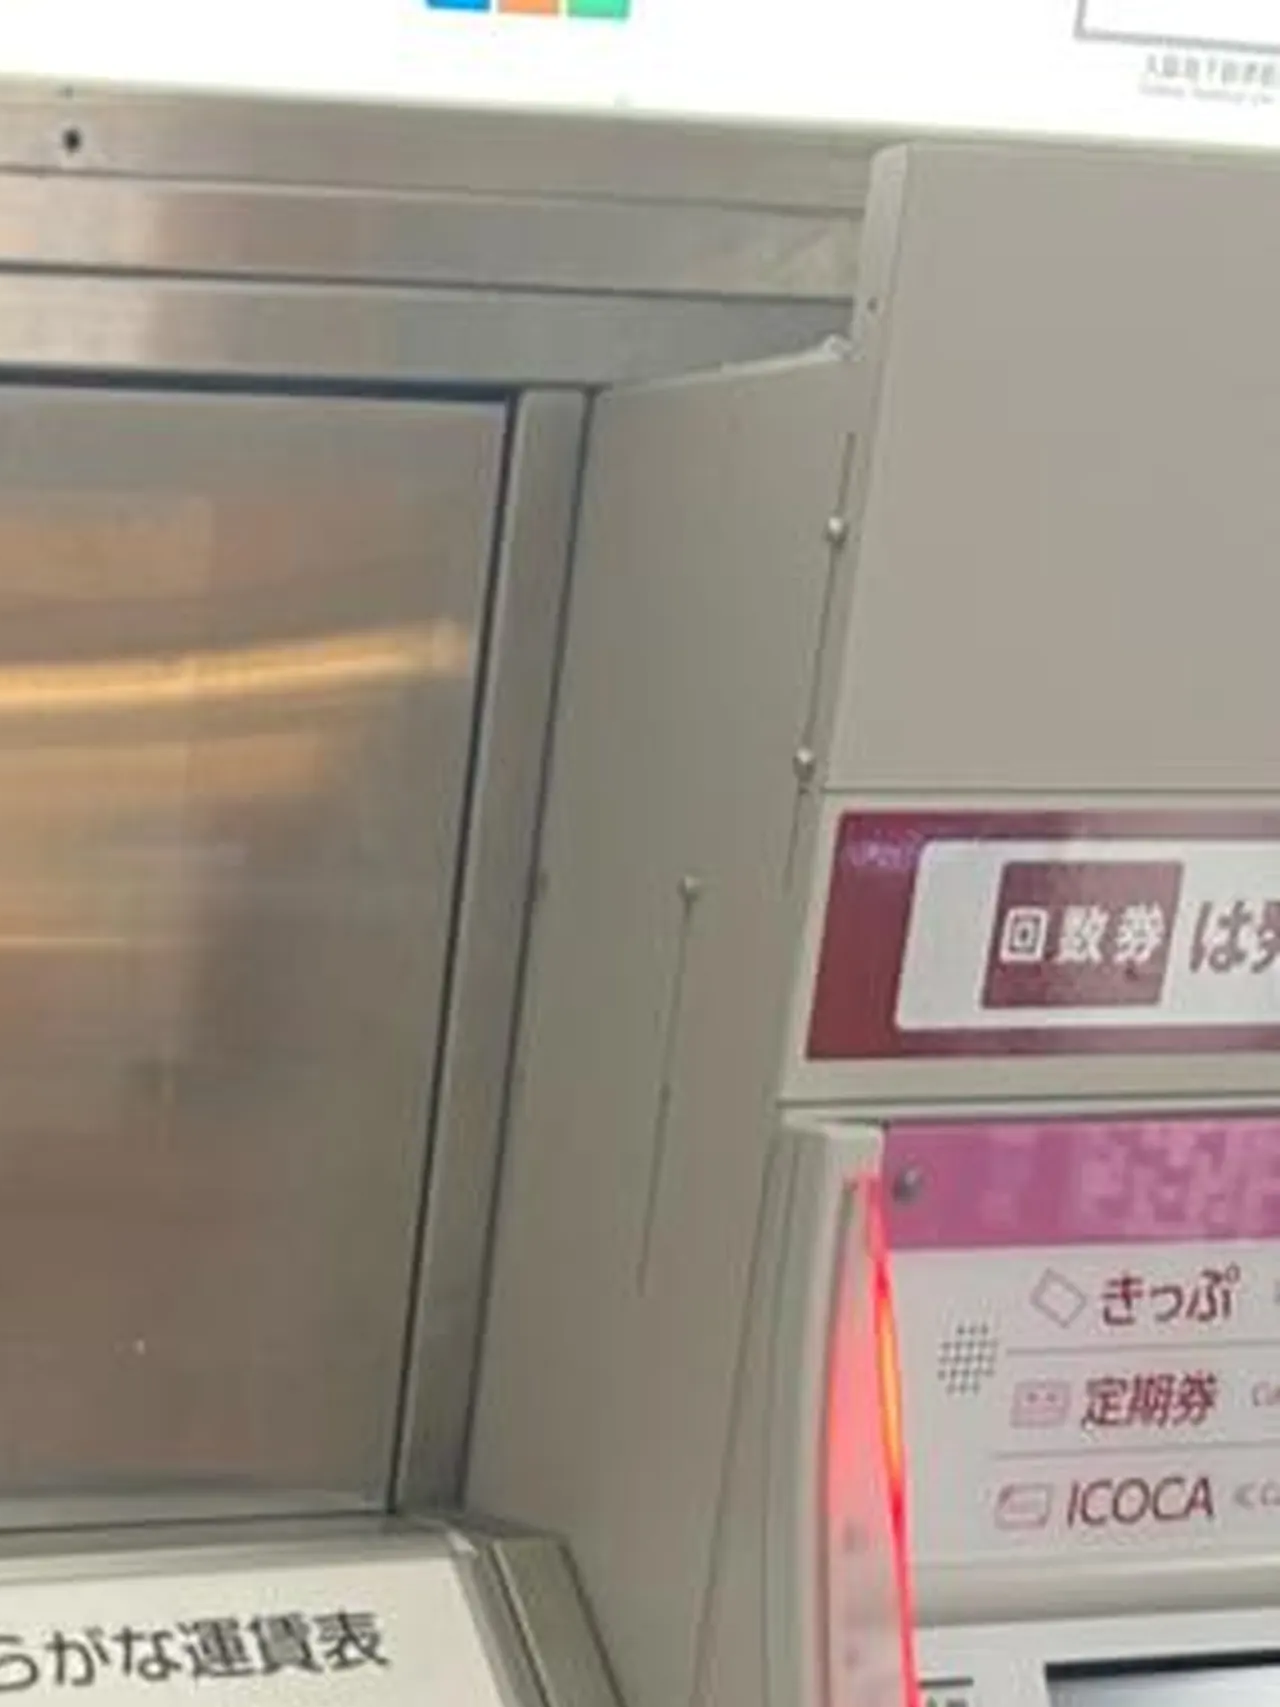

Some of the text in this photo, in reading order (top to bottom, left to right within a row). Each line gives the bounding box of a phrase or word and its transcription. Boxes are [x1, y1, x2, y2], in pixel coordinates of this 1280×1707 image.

[1000, 902, 1165, 964] 回数券
[1100, 1264, 1242, 1326] きっぷ
[1080, 1372, 1218, 1429] 定期券
[1066, 1476, 1216, 1530] ICOCA
